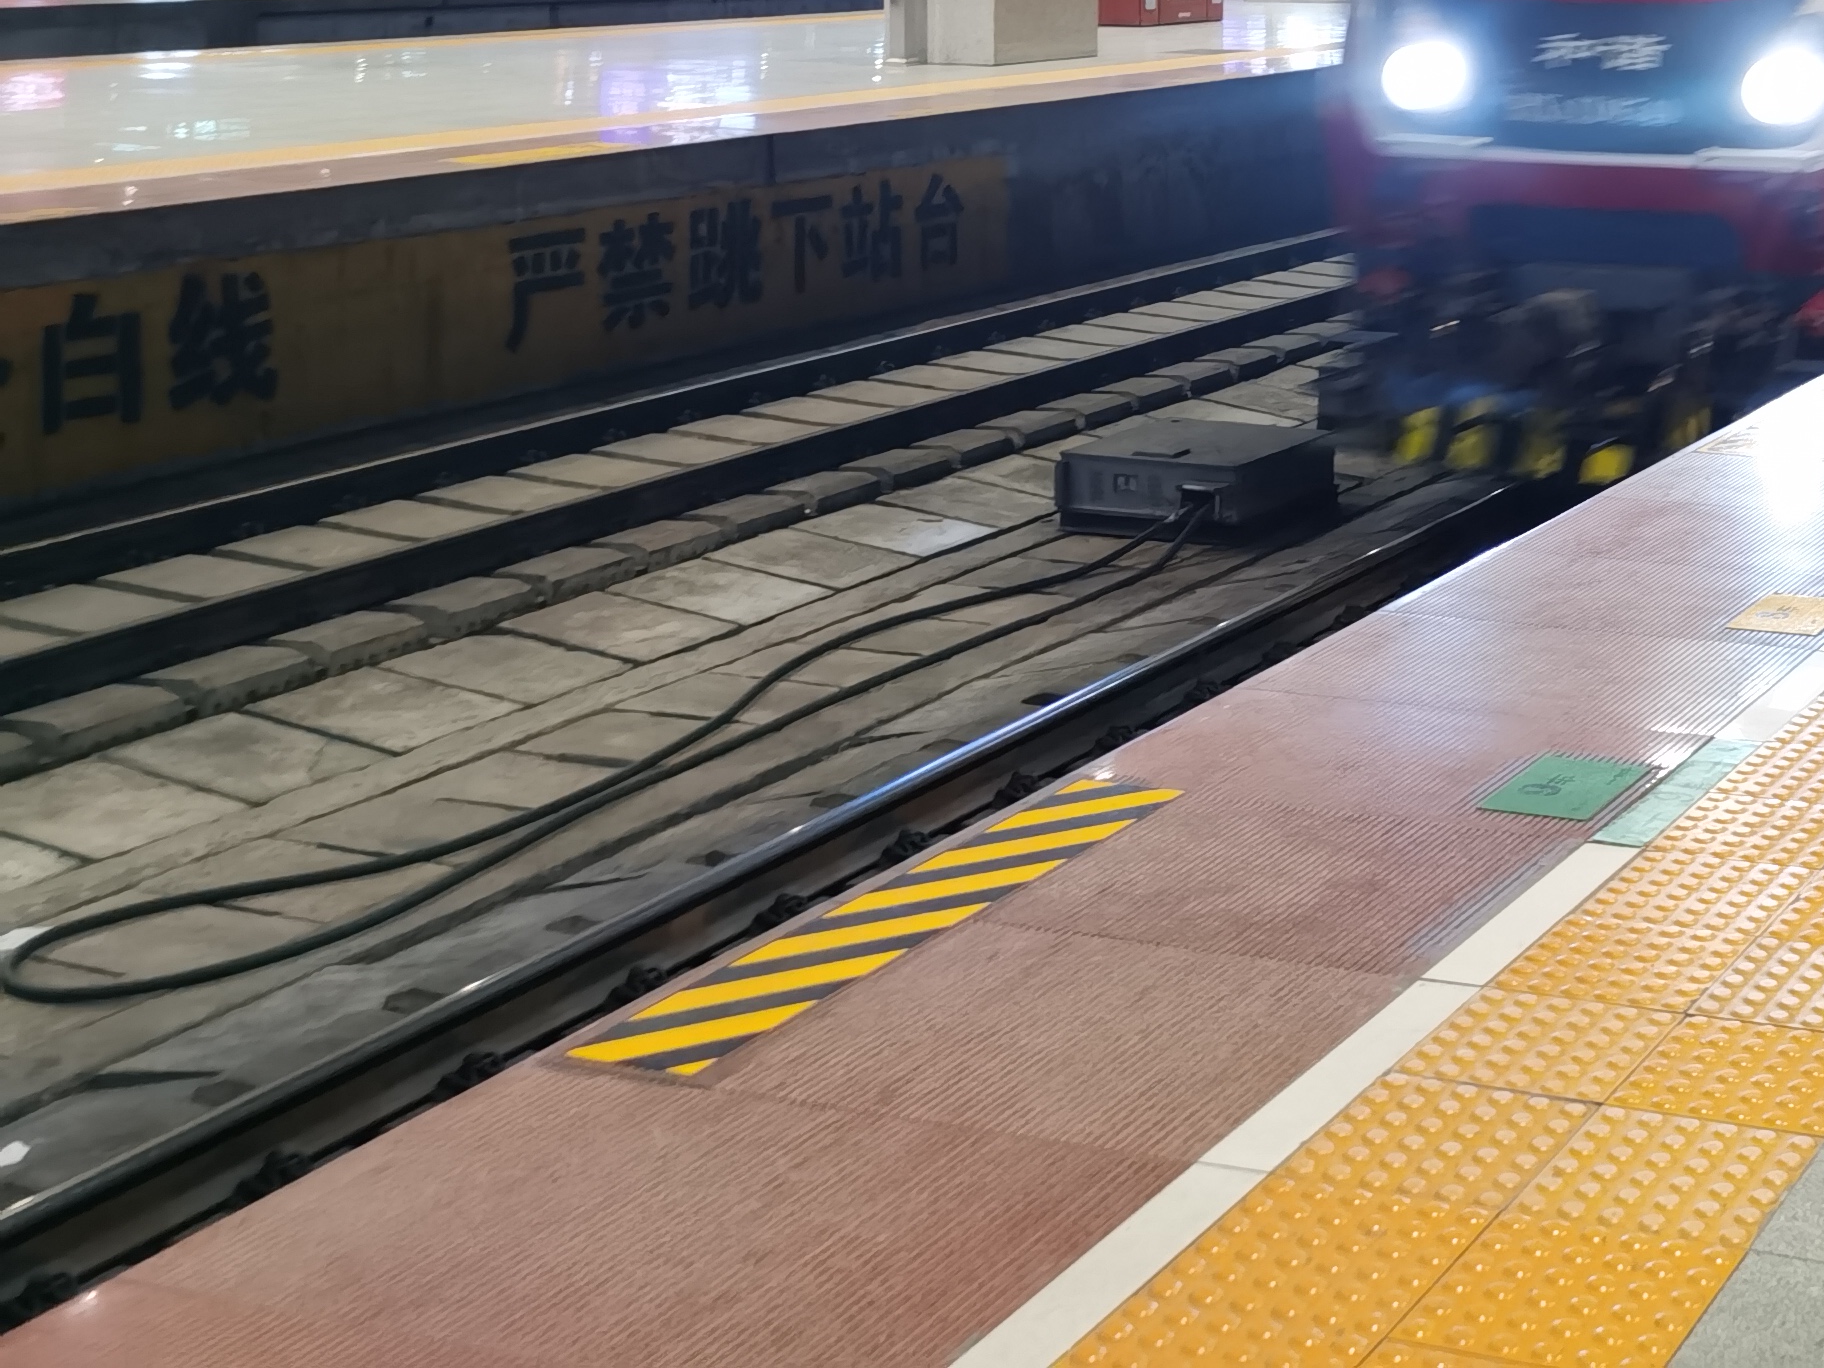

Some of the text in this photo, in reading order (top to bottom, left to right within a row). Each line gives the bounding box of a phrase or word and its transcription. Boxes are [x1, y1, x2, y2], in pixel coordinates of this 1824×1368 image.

[504, 172, 966, 353] 严禁跳下站台
